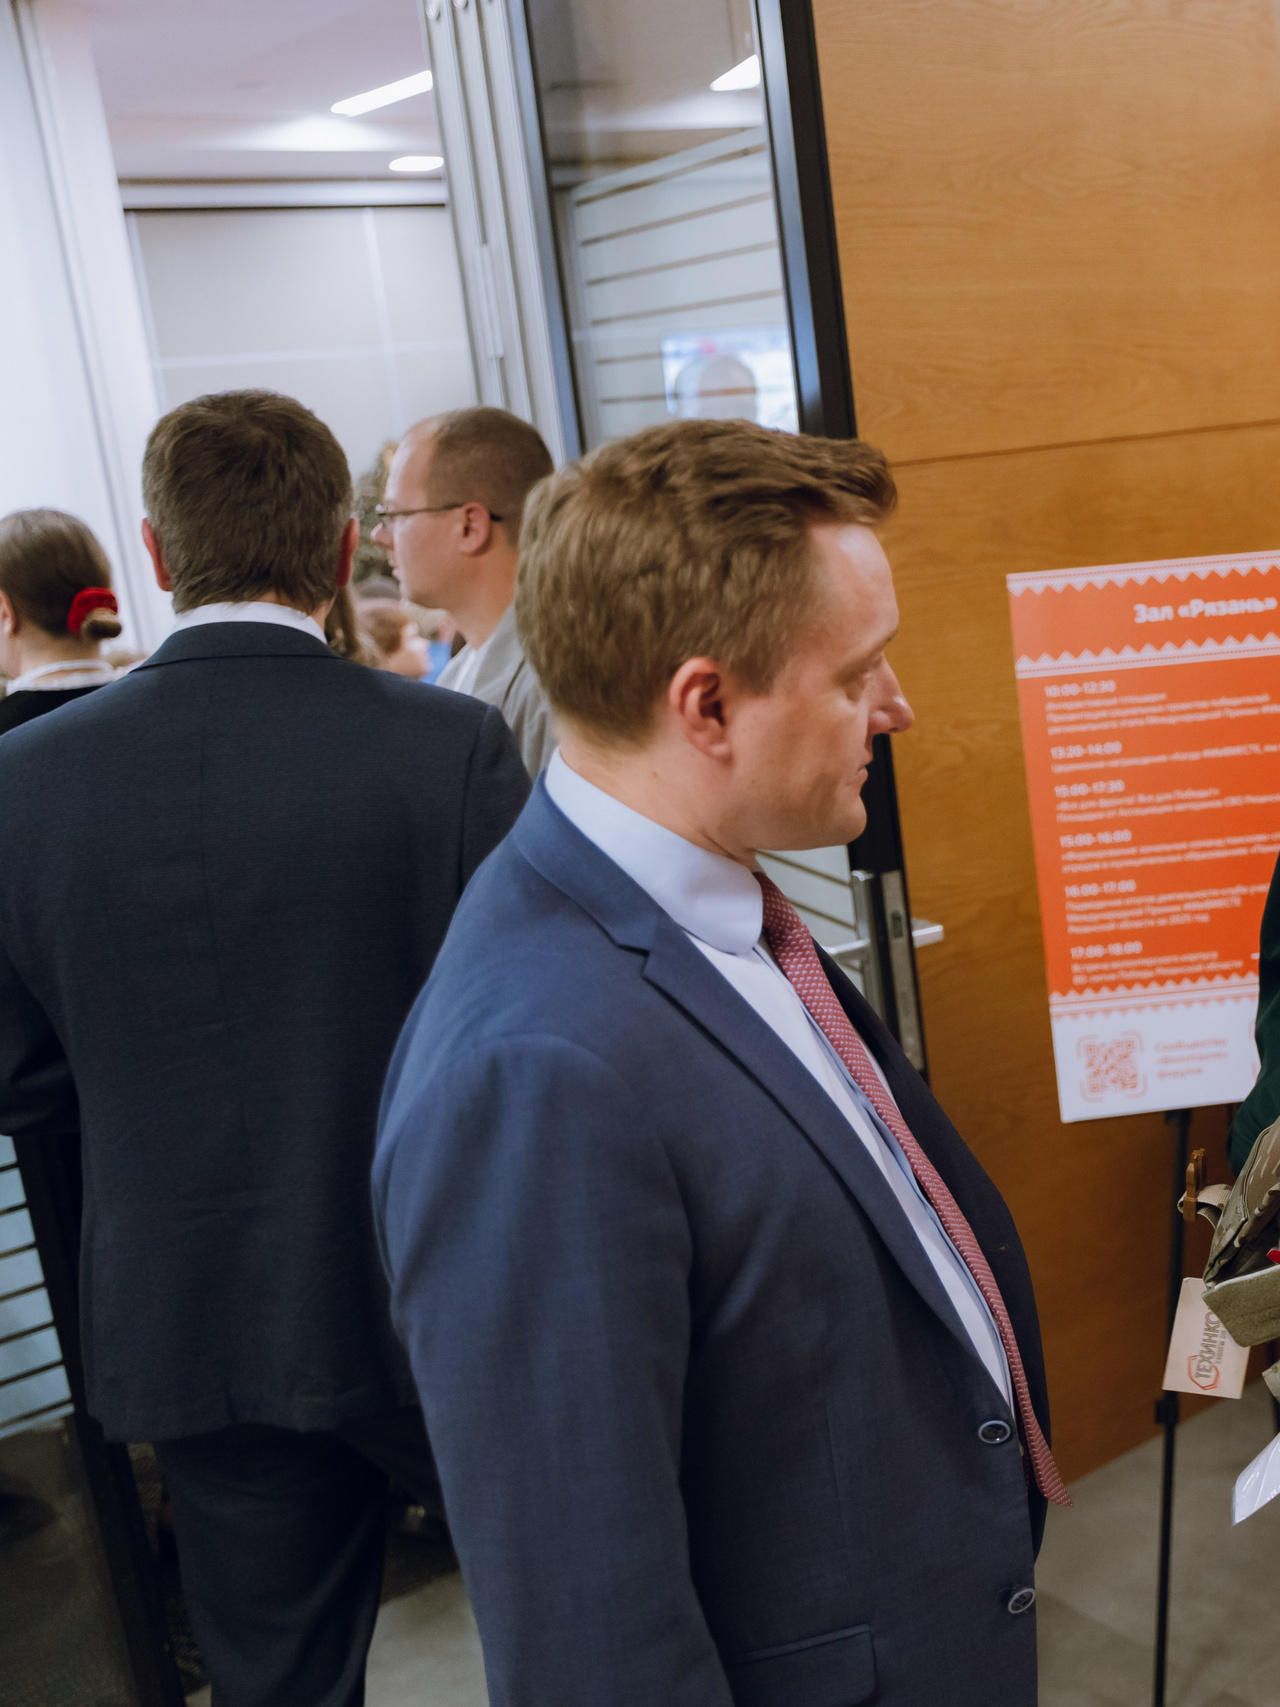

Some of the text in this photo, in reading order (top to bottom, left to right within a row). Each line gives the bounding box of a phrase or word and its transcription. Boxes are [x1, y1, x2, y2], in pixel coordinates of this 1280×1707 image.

[1132, 592, 1278, 623] Зал «Рязань»
[1196, 1307, 1220, 1378] ТЕХИНКО
